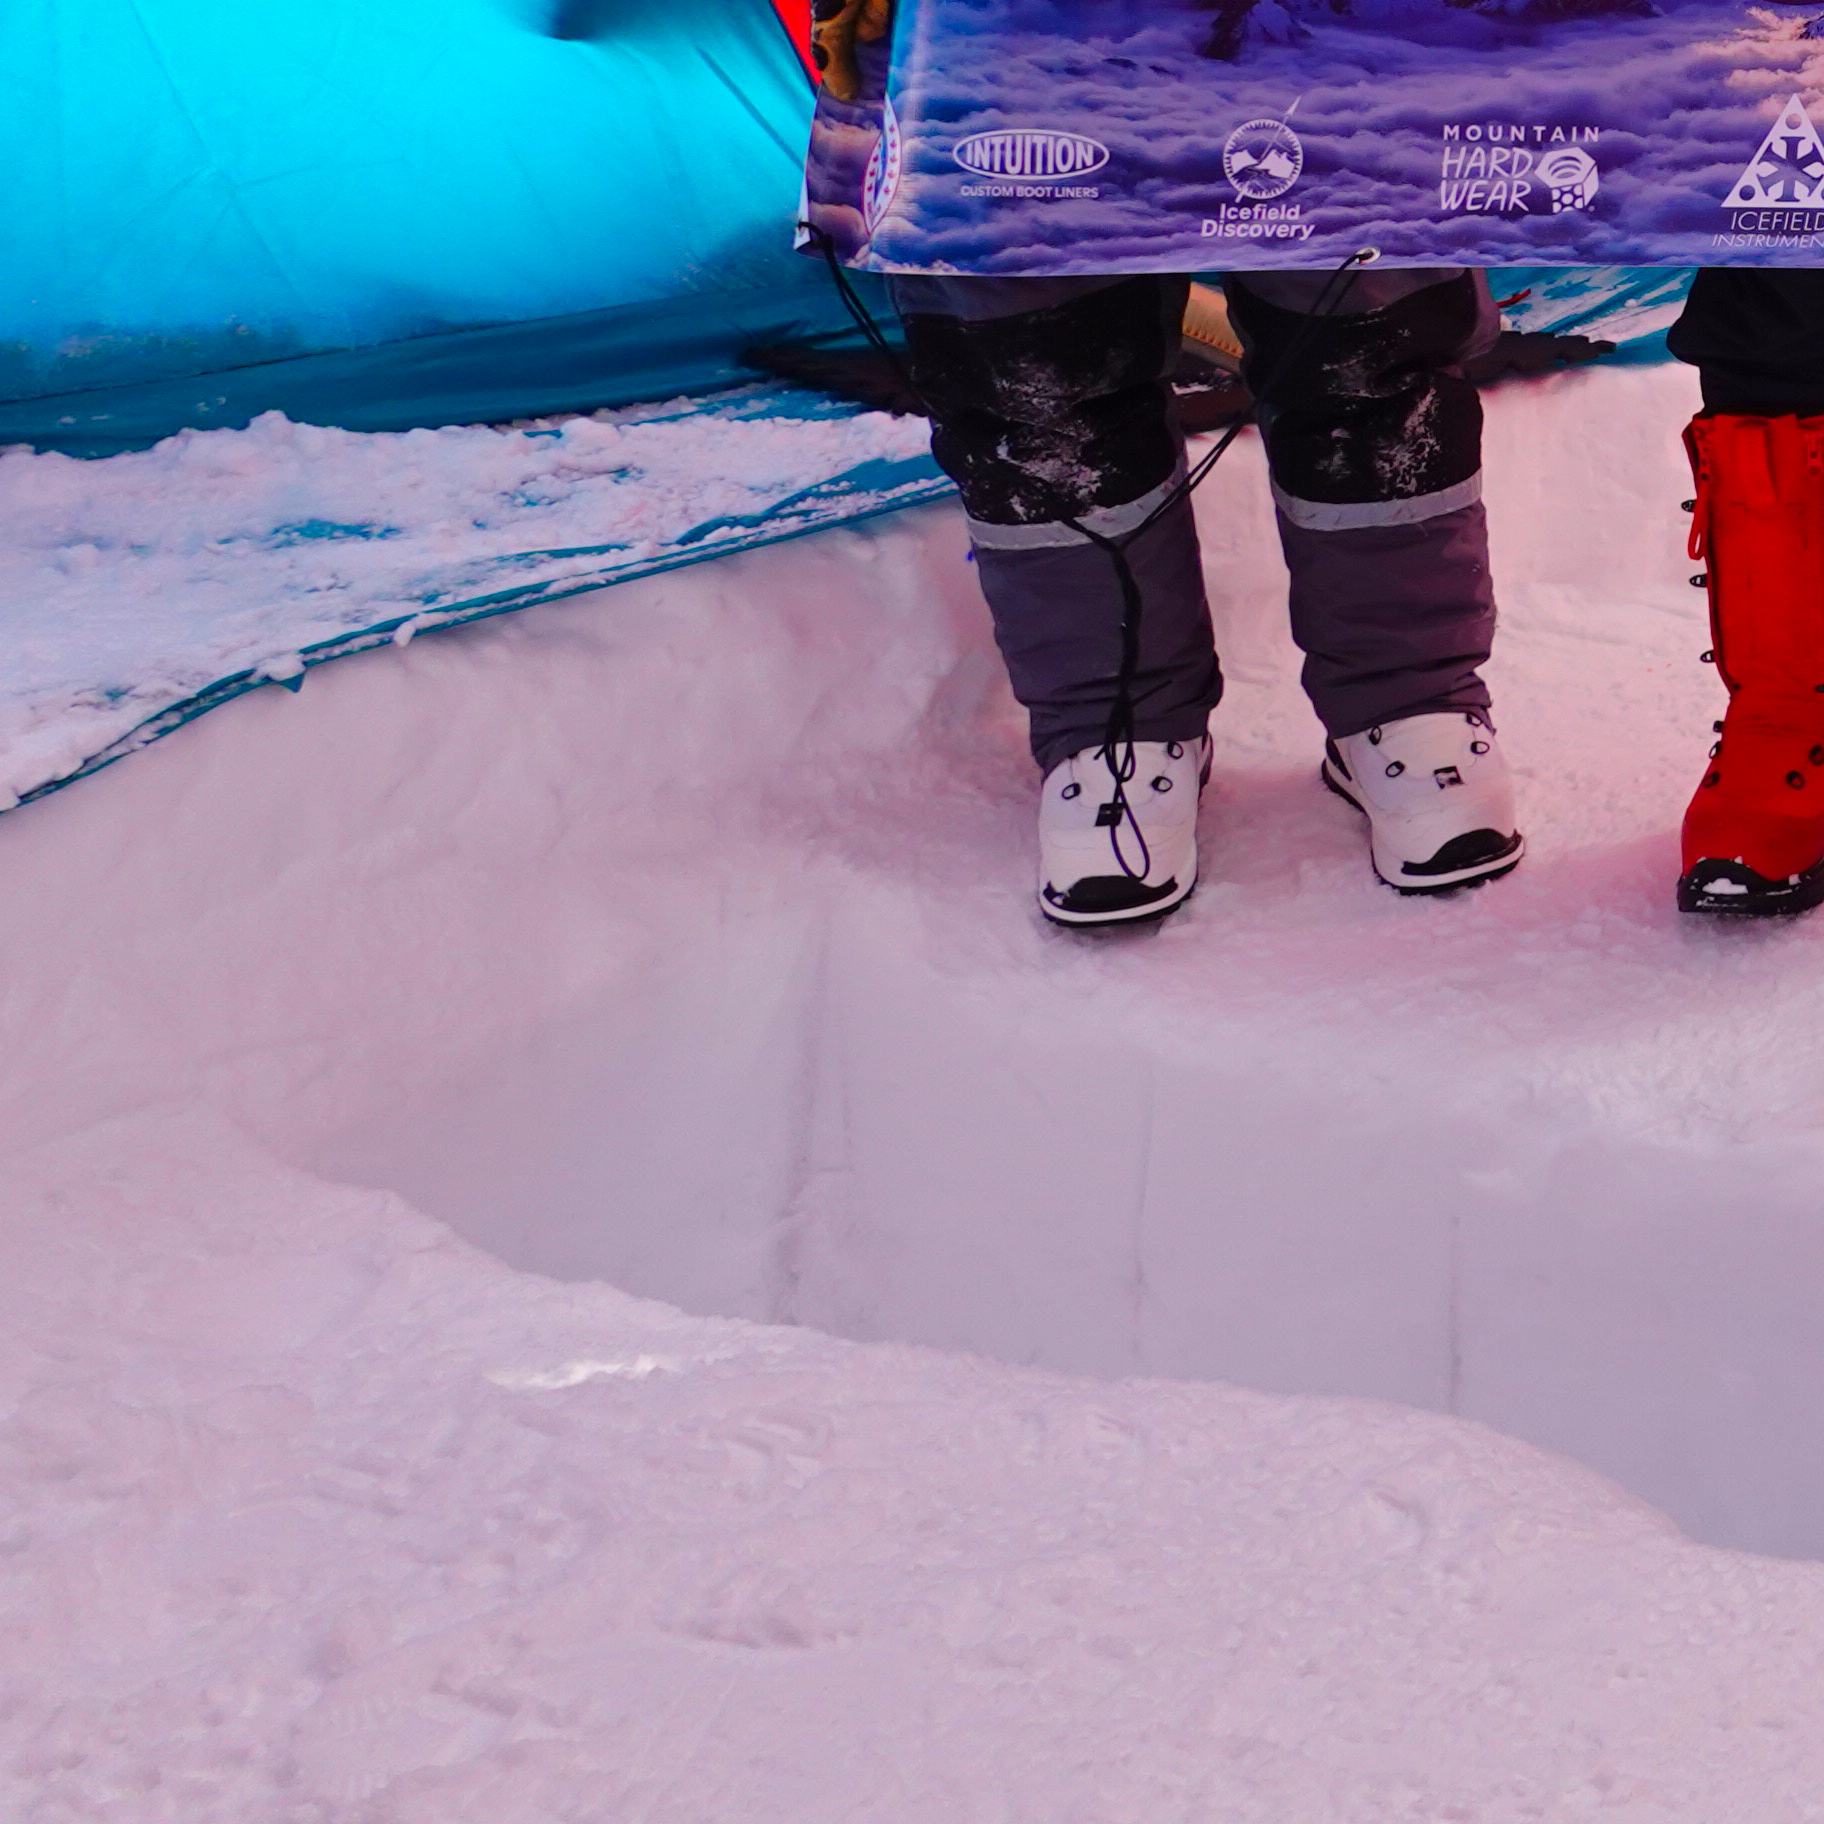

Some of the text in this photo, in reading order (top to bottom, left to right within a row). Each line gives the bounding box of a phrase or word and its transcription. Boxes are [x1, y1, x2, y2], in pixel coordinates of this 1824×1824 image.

[1442, 124, 1600, 143] MOUNTAIN
[966, 134, 1094, 175] INTUITION
[1441, 146, 1534, 179] HARD
[960, 185, 1099, 199] CUSTOM BOOT LINERS
[1439, 178, 1532, 212] WEAR
[1219, 203, 1301, 221] Icefield
[1200, 218, 1316, 241] Discovery
